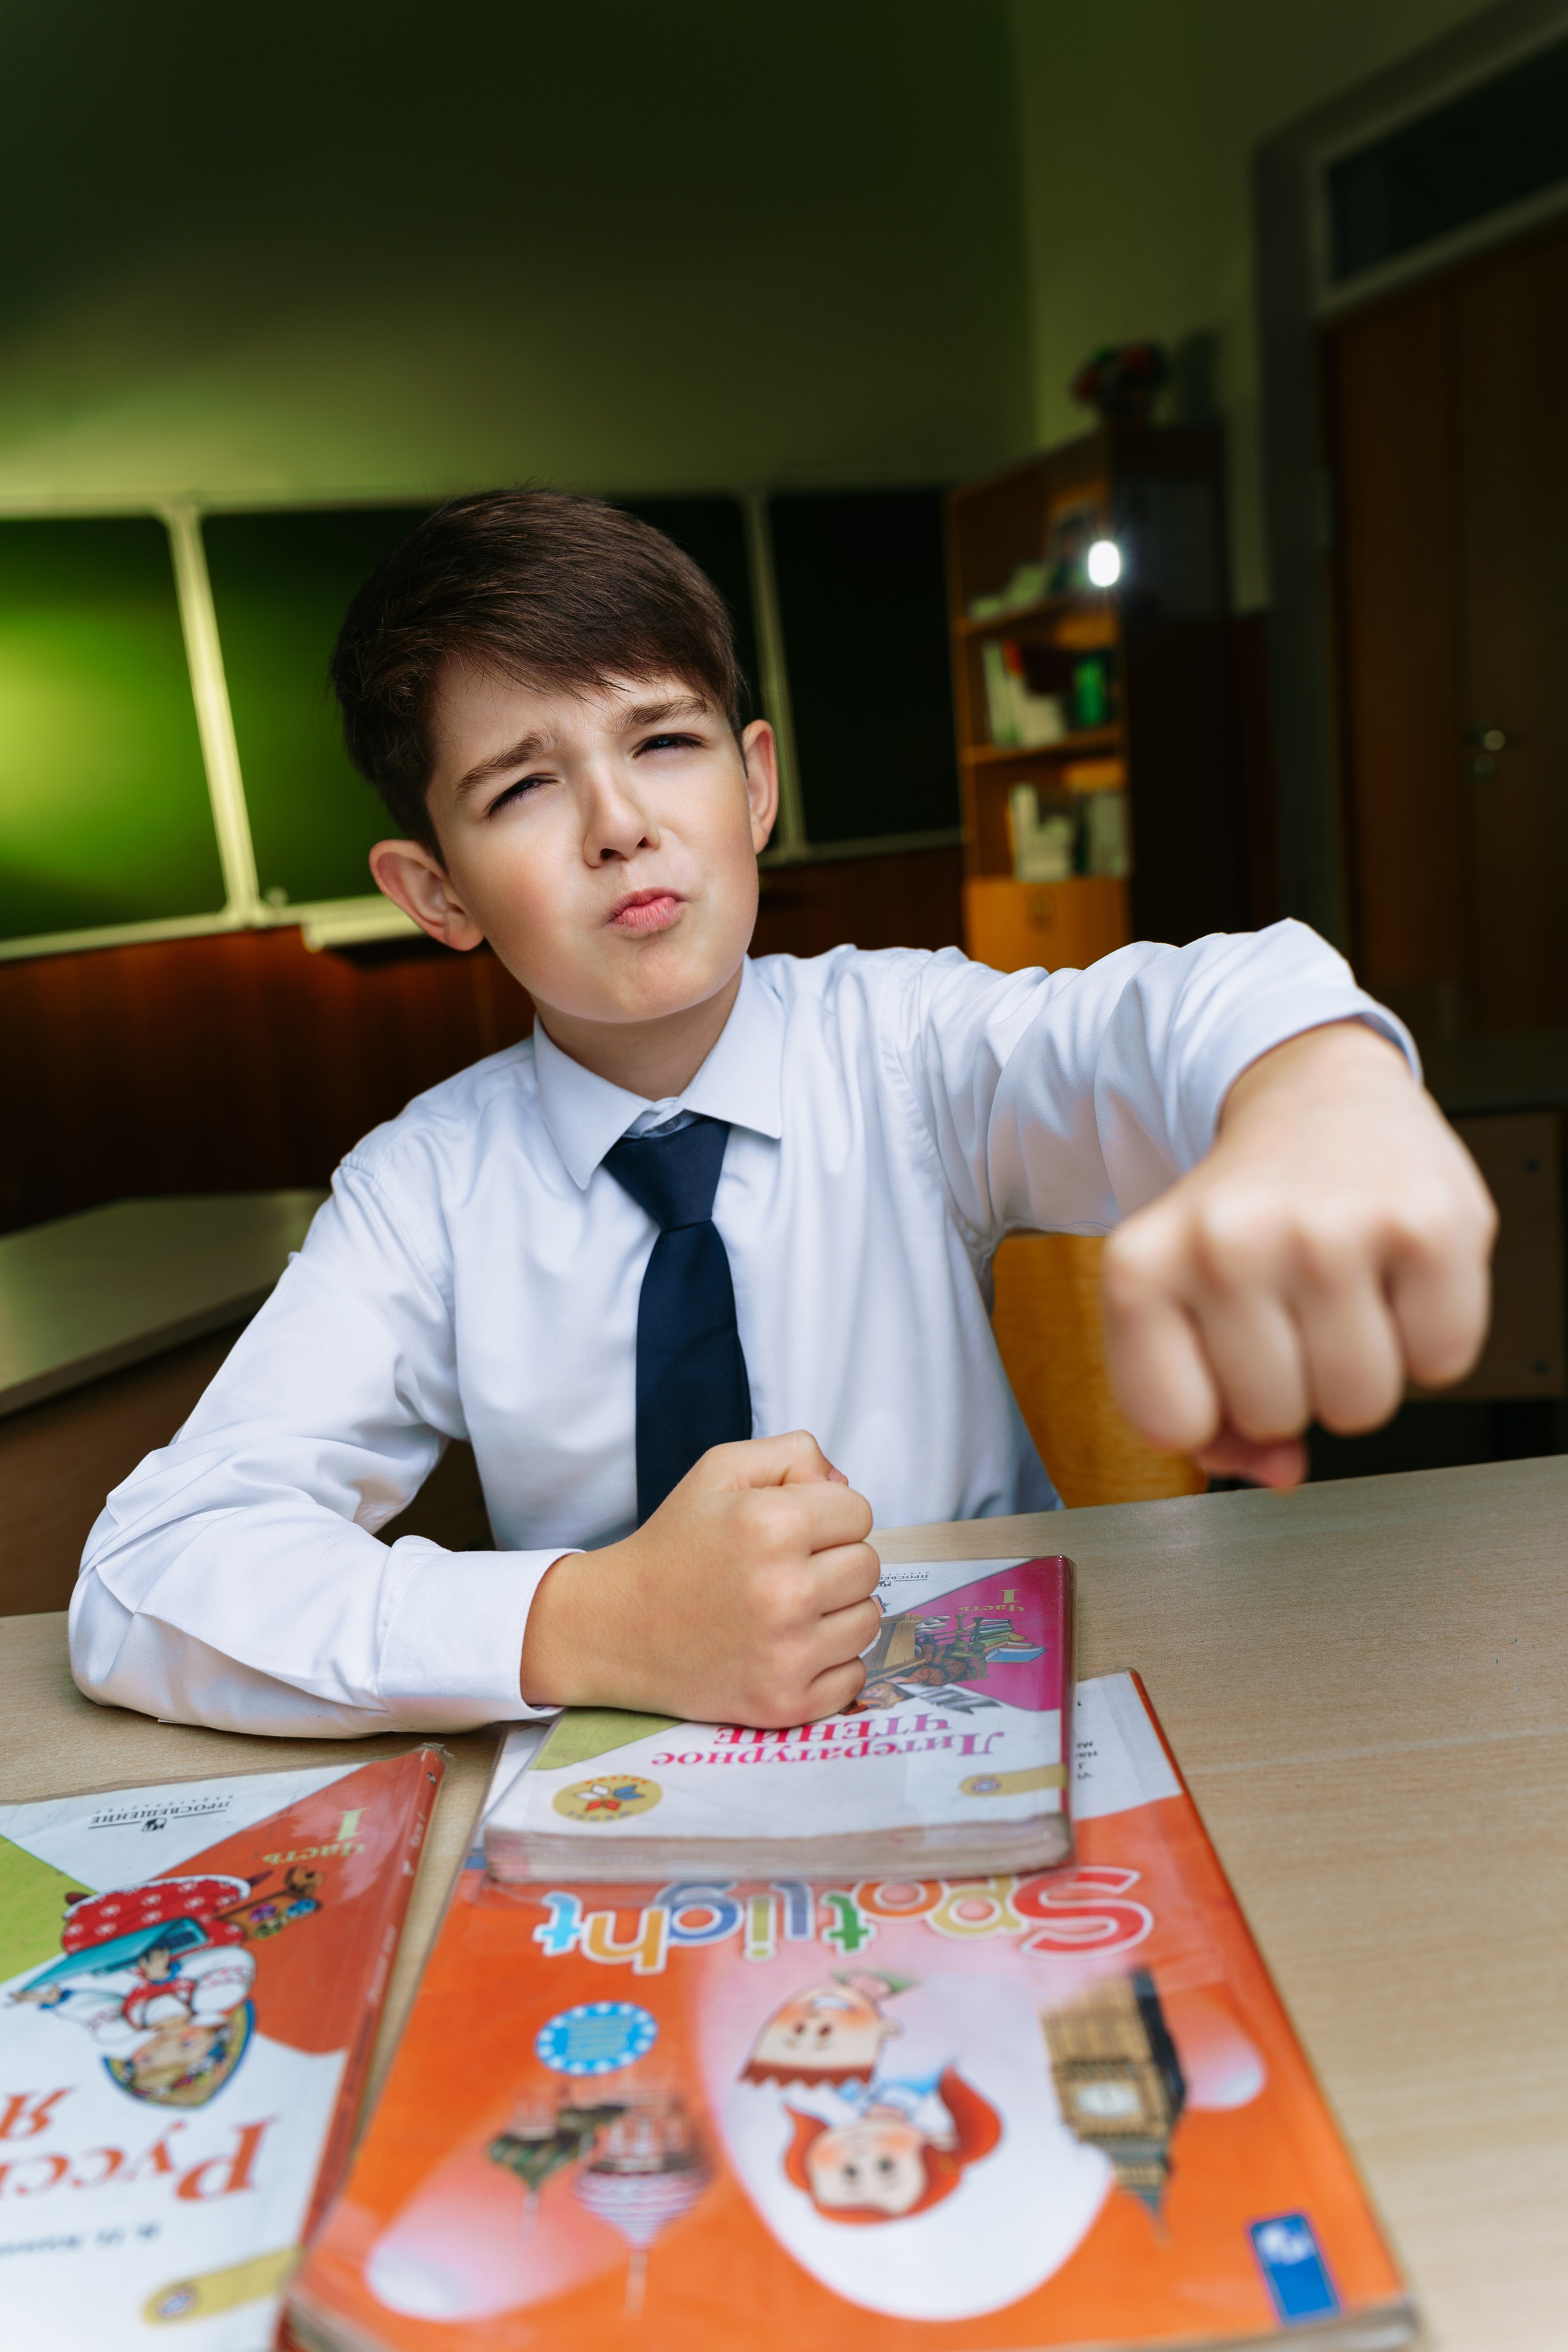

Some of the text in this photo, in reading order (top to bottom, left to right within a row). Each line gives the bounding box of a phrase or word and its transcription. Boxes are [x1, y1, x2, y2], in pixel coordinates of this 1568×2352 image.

[998, 1589, 1020, 1604] 1
[714, 1713, 952, 1744] ЧТЕНИЕ
[650, 1730, 1005, 1766] Литературное
[90, 1801, 230, 1824] ПРОСВЕЩЕНИЕ
[336, 1807, 371, 1842] 1
[533, 1866, 1153, 1975] Spotlight
[0, 2115, 280, 2204] Русс
